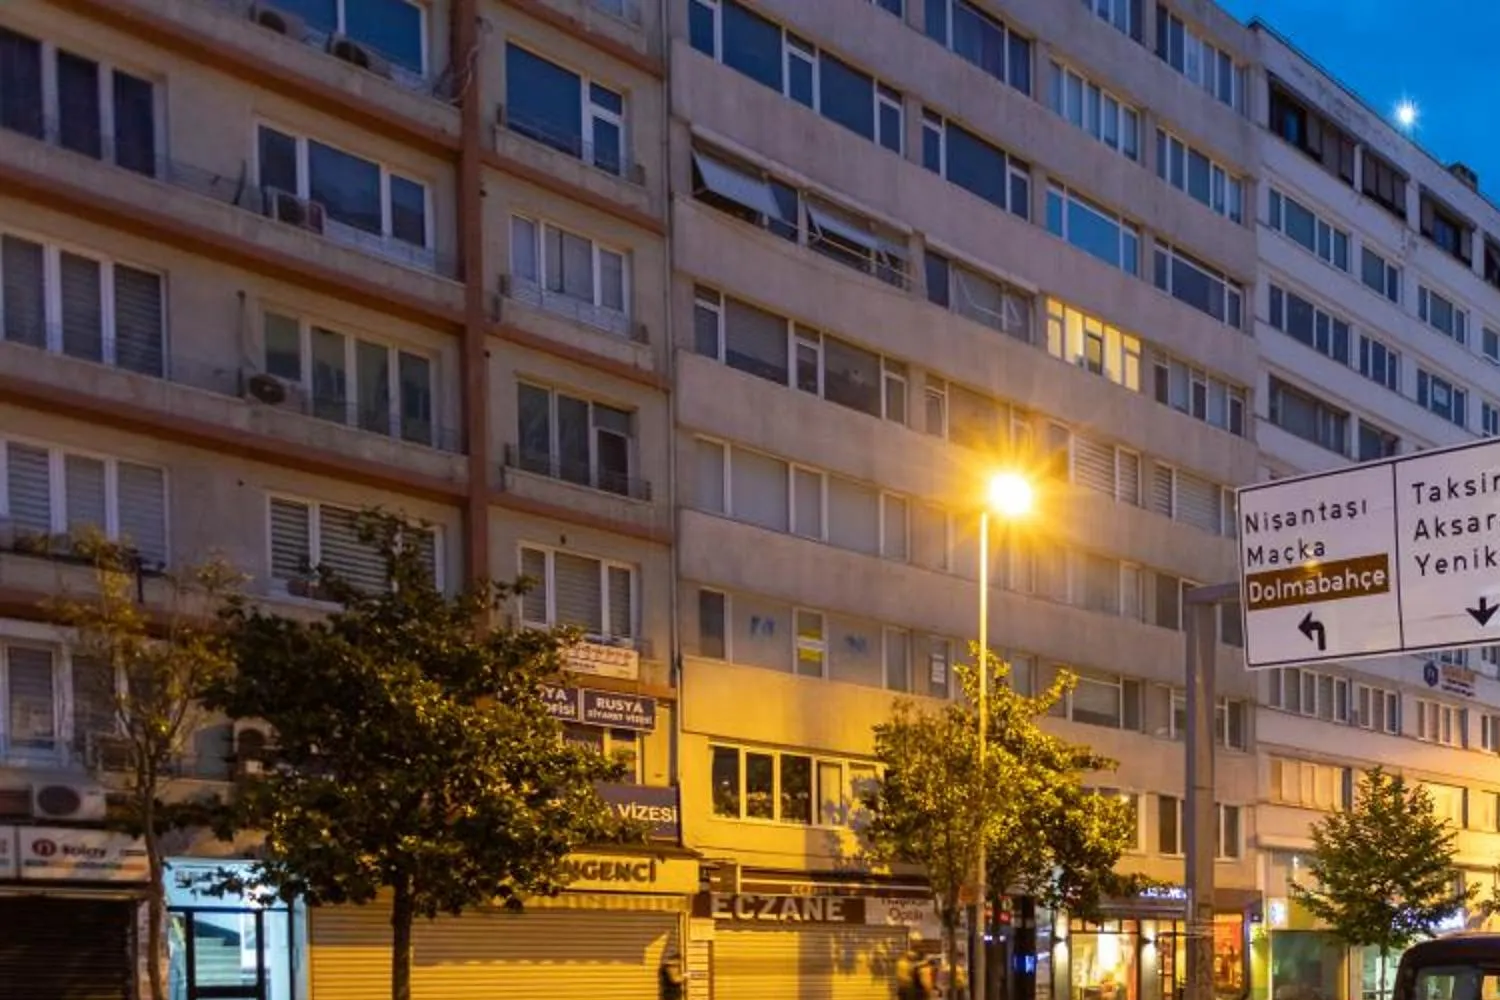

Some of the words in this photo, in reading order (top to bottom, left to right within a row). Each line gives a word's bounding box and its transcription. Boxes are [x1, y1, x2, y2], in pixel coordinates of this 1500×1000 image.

[1245, 499, 1367, 533] Nişantaşı
[1247, 539, 1325, 567] Maçka
[1249, 567, 1386, 602] Dolmabahçe
[596, 697, 644, 713] RUSYA
[617, 801, 678, 823] VİZESİ
[712, 892, 845, 921] ECZANE
